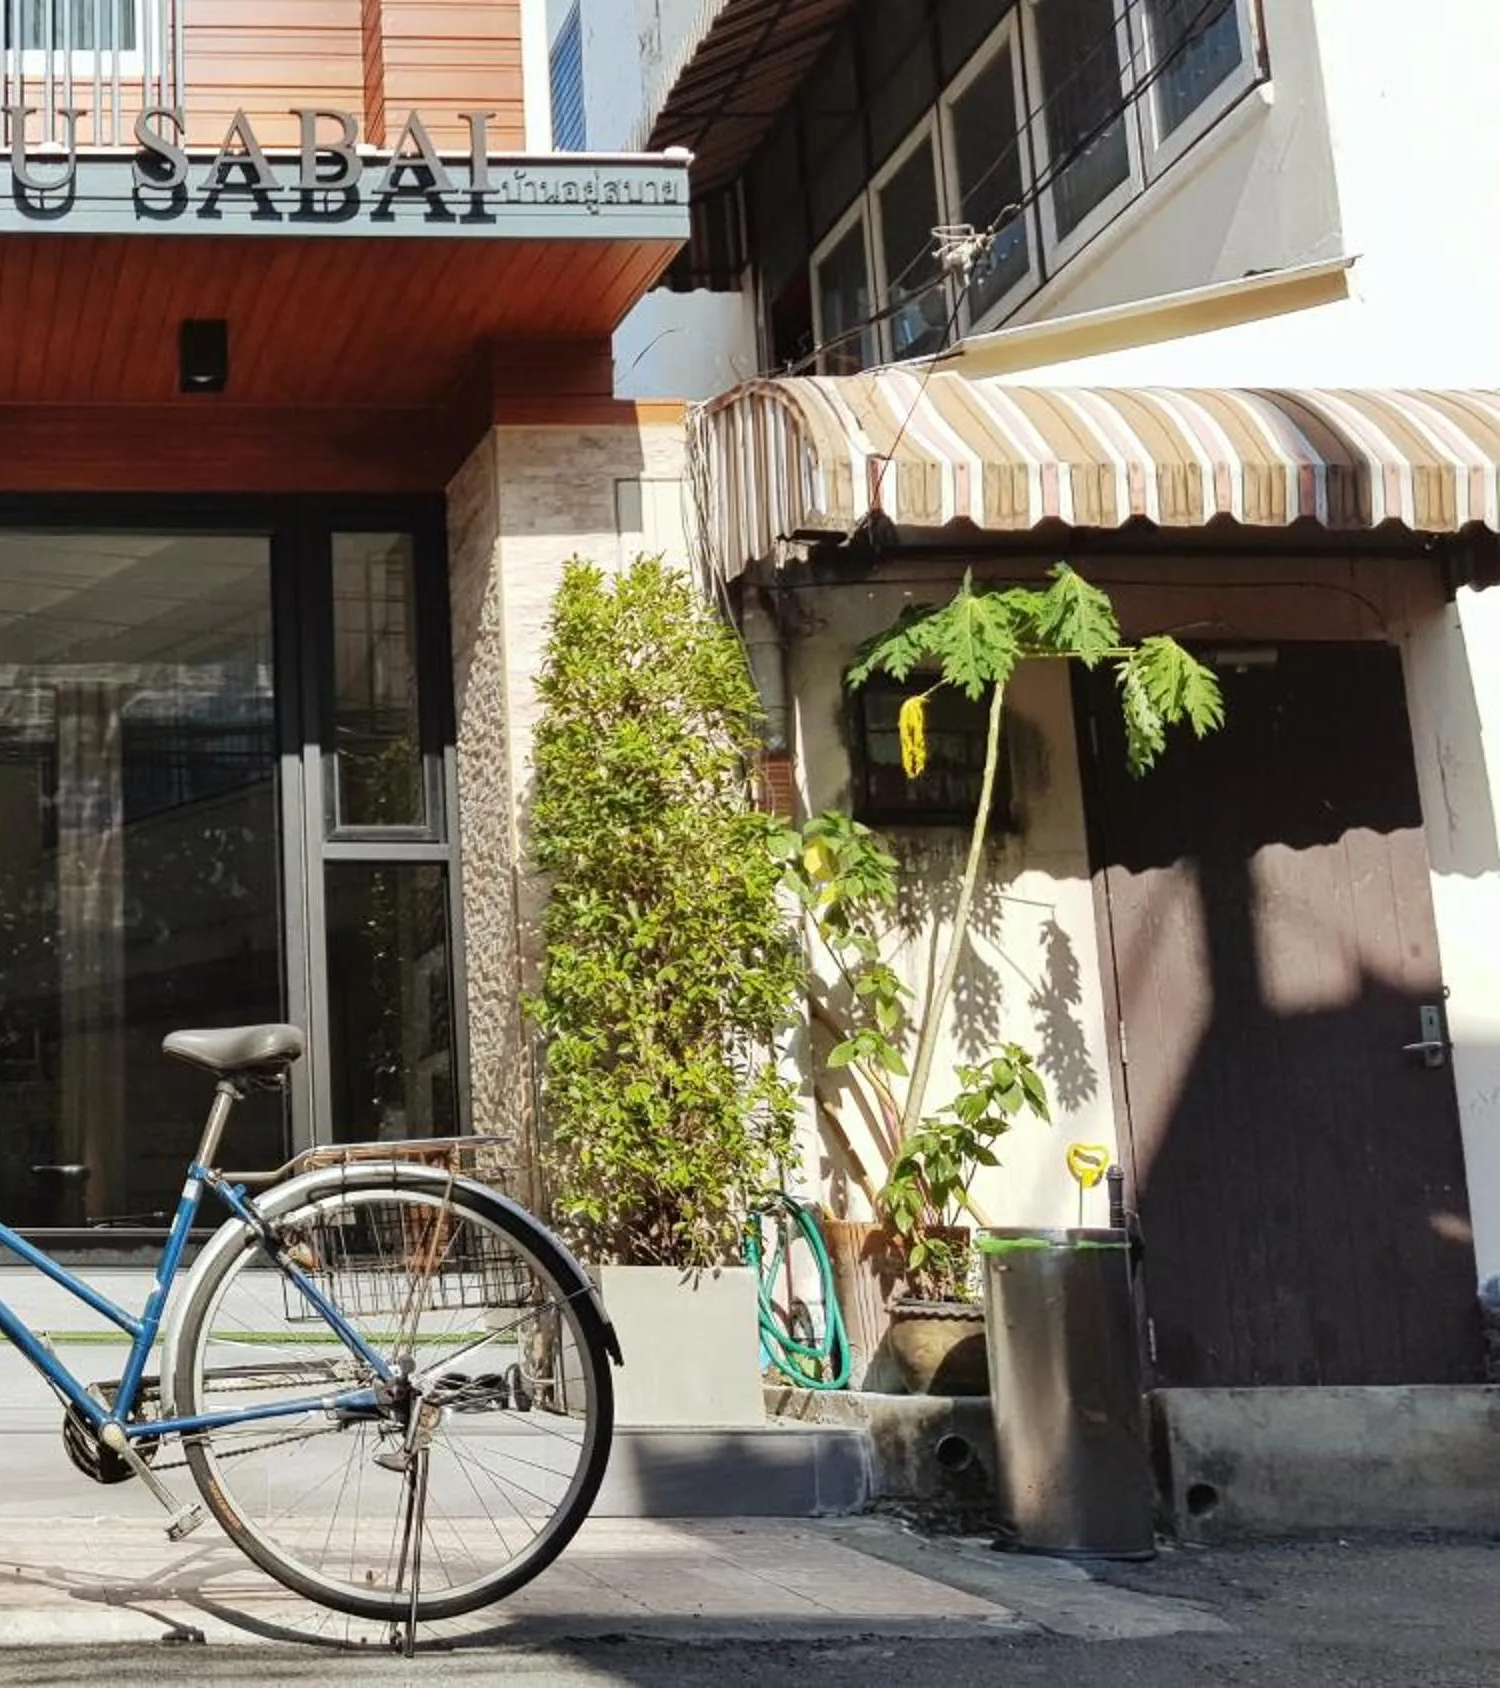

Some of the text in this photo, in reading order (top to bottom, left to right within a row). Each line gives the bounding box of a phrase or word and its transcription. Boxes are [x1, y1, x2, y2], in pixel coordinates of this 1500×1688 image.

[1, 106, 88, 191] U
[133, 106, 501, 193] SABAI
[501, 168, 679, 216] บ้านอยู่สบาย
